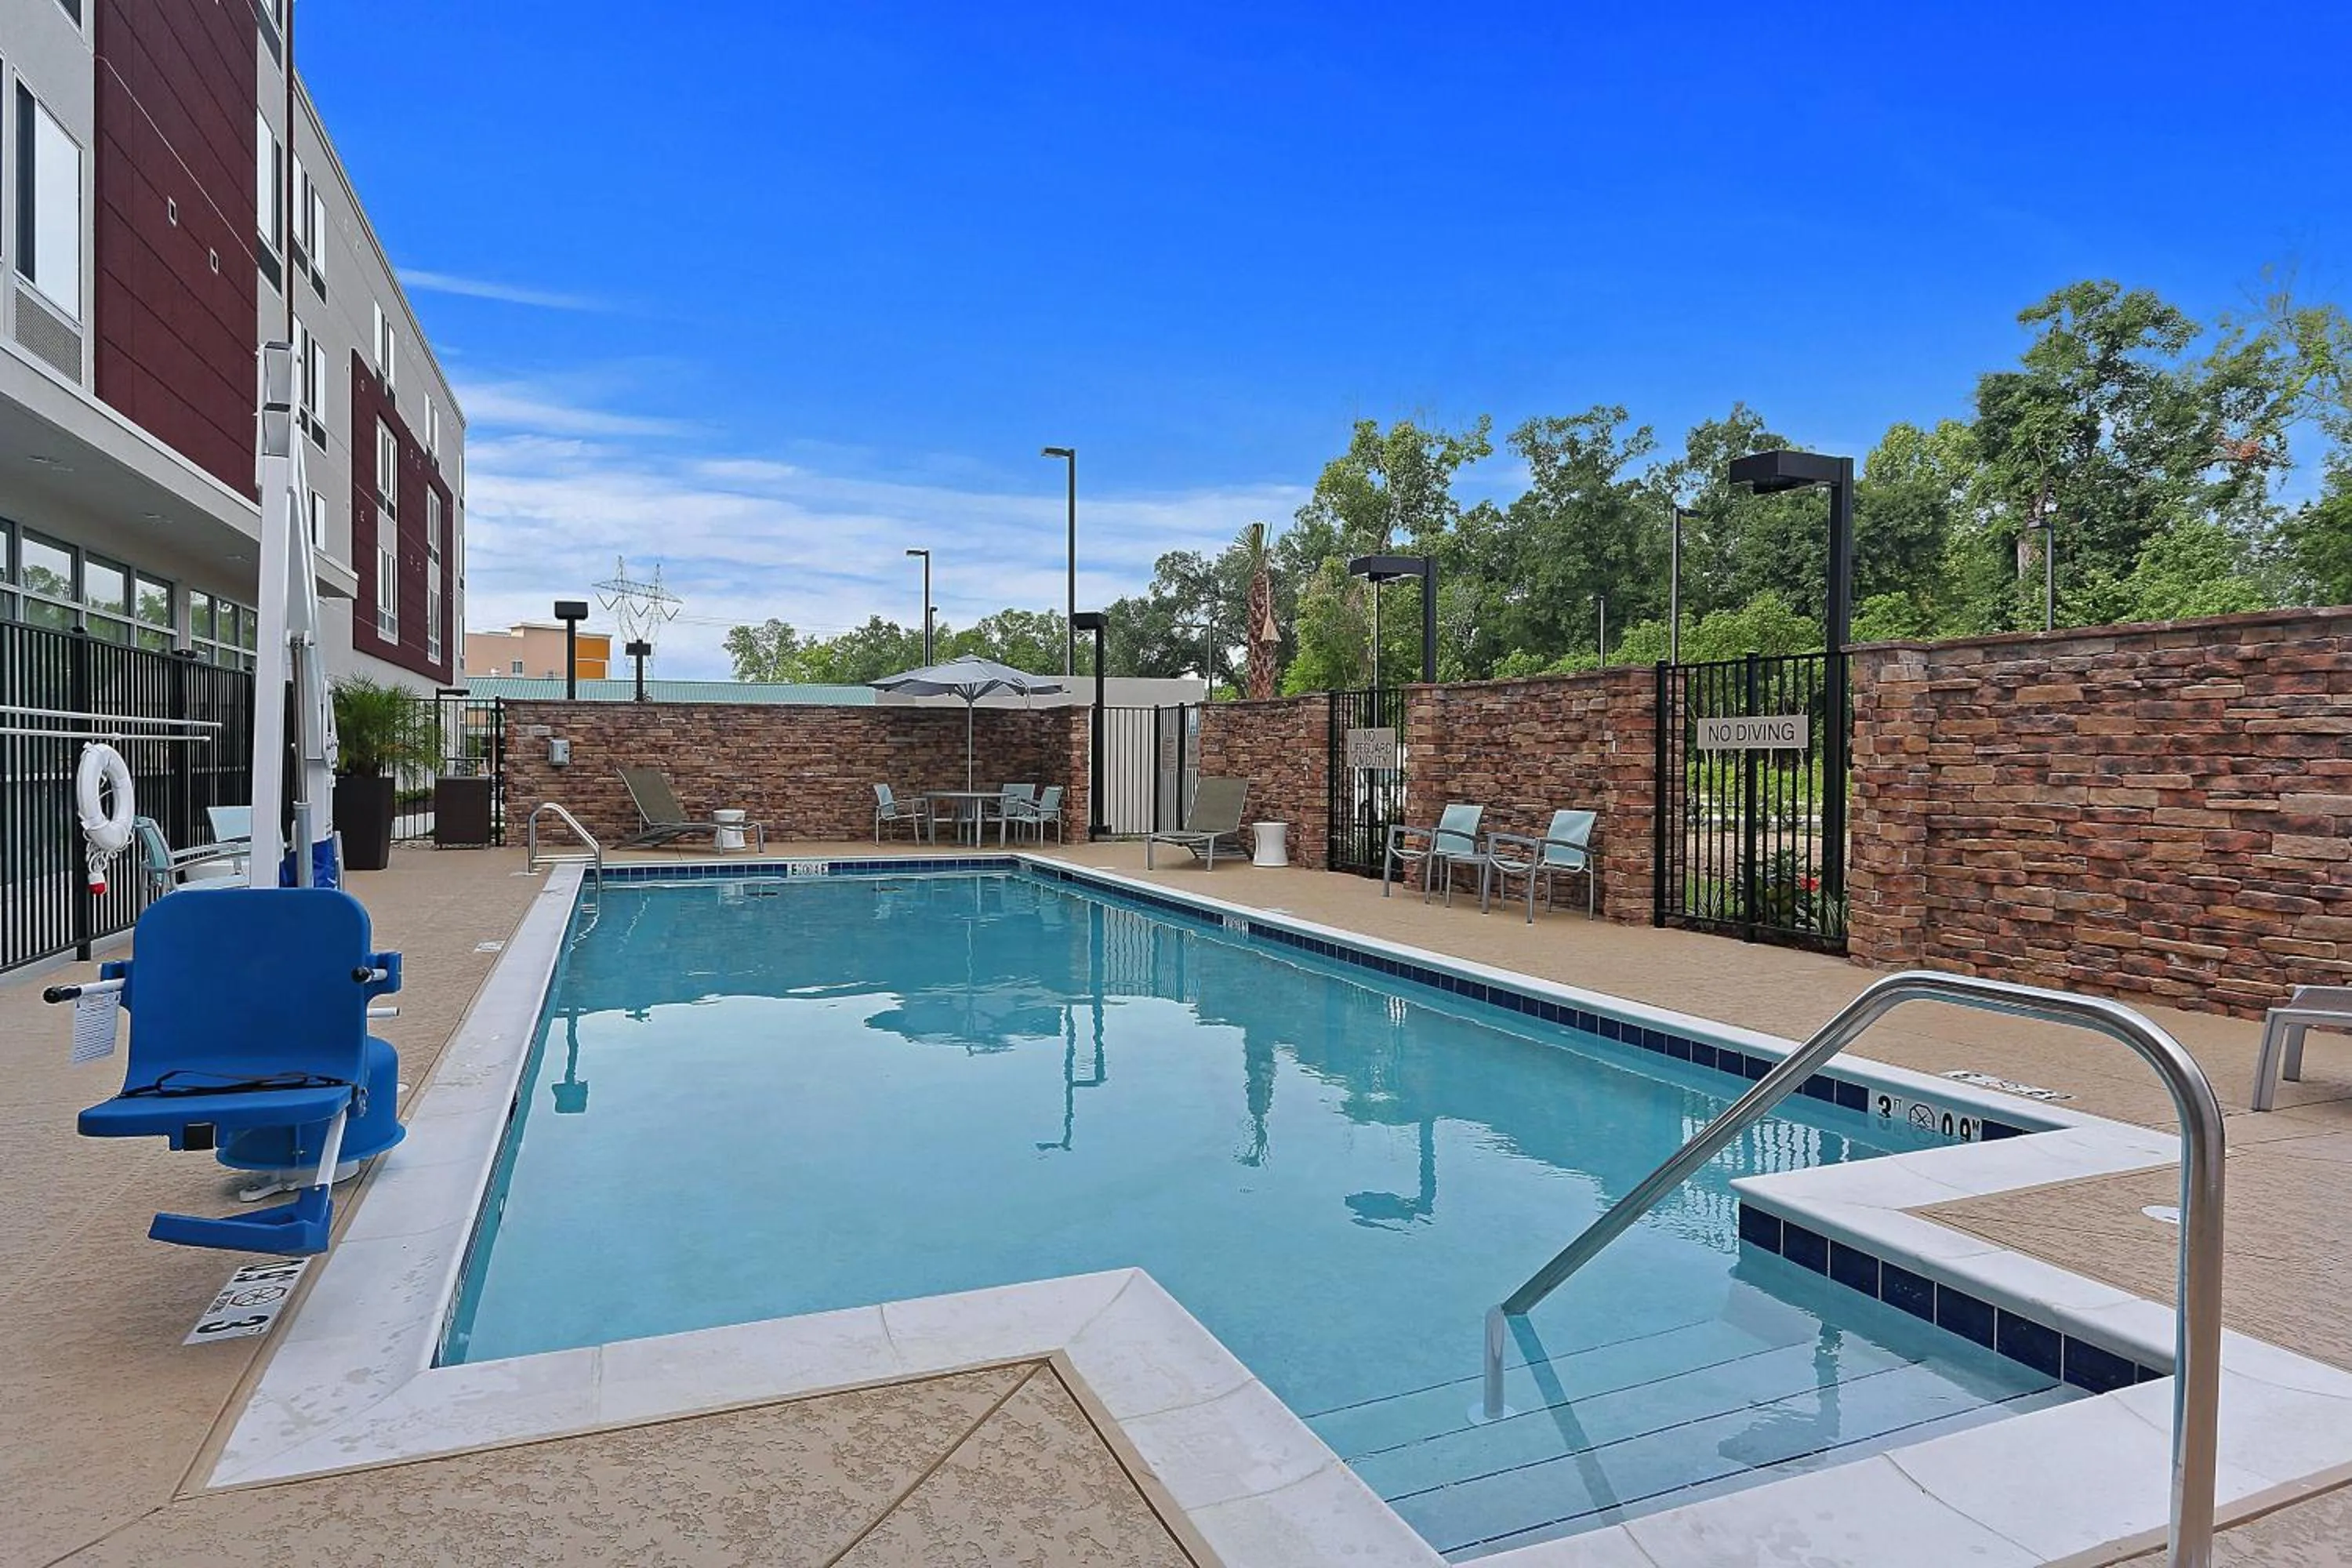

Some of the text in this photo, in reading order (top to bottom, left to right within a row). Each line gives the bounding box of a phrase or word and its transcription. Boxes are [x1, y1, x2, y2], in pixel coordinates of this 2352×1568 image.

[1363, 730, 1376, 742] NO
[1708, 722, 1795, 742] NO DIVING
